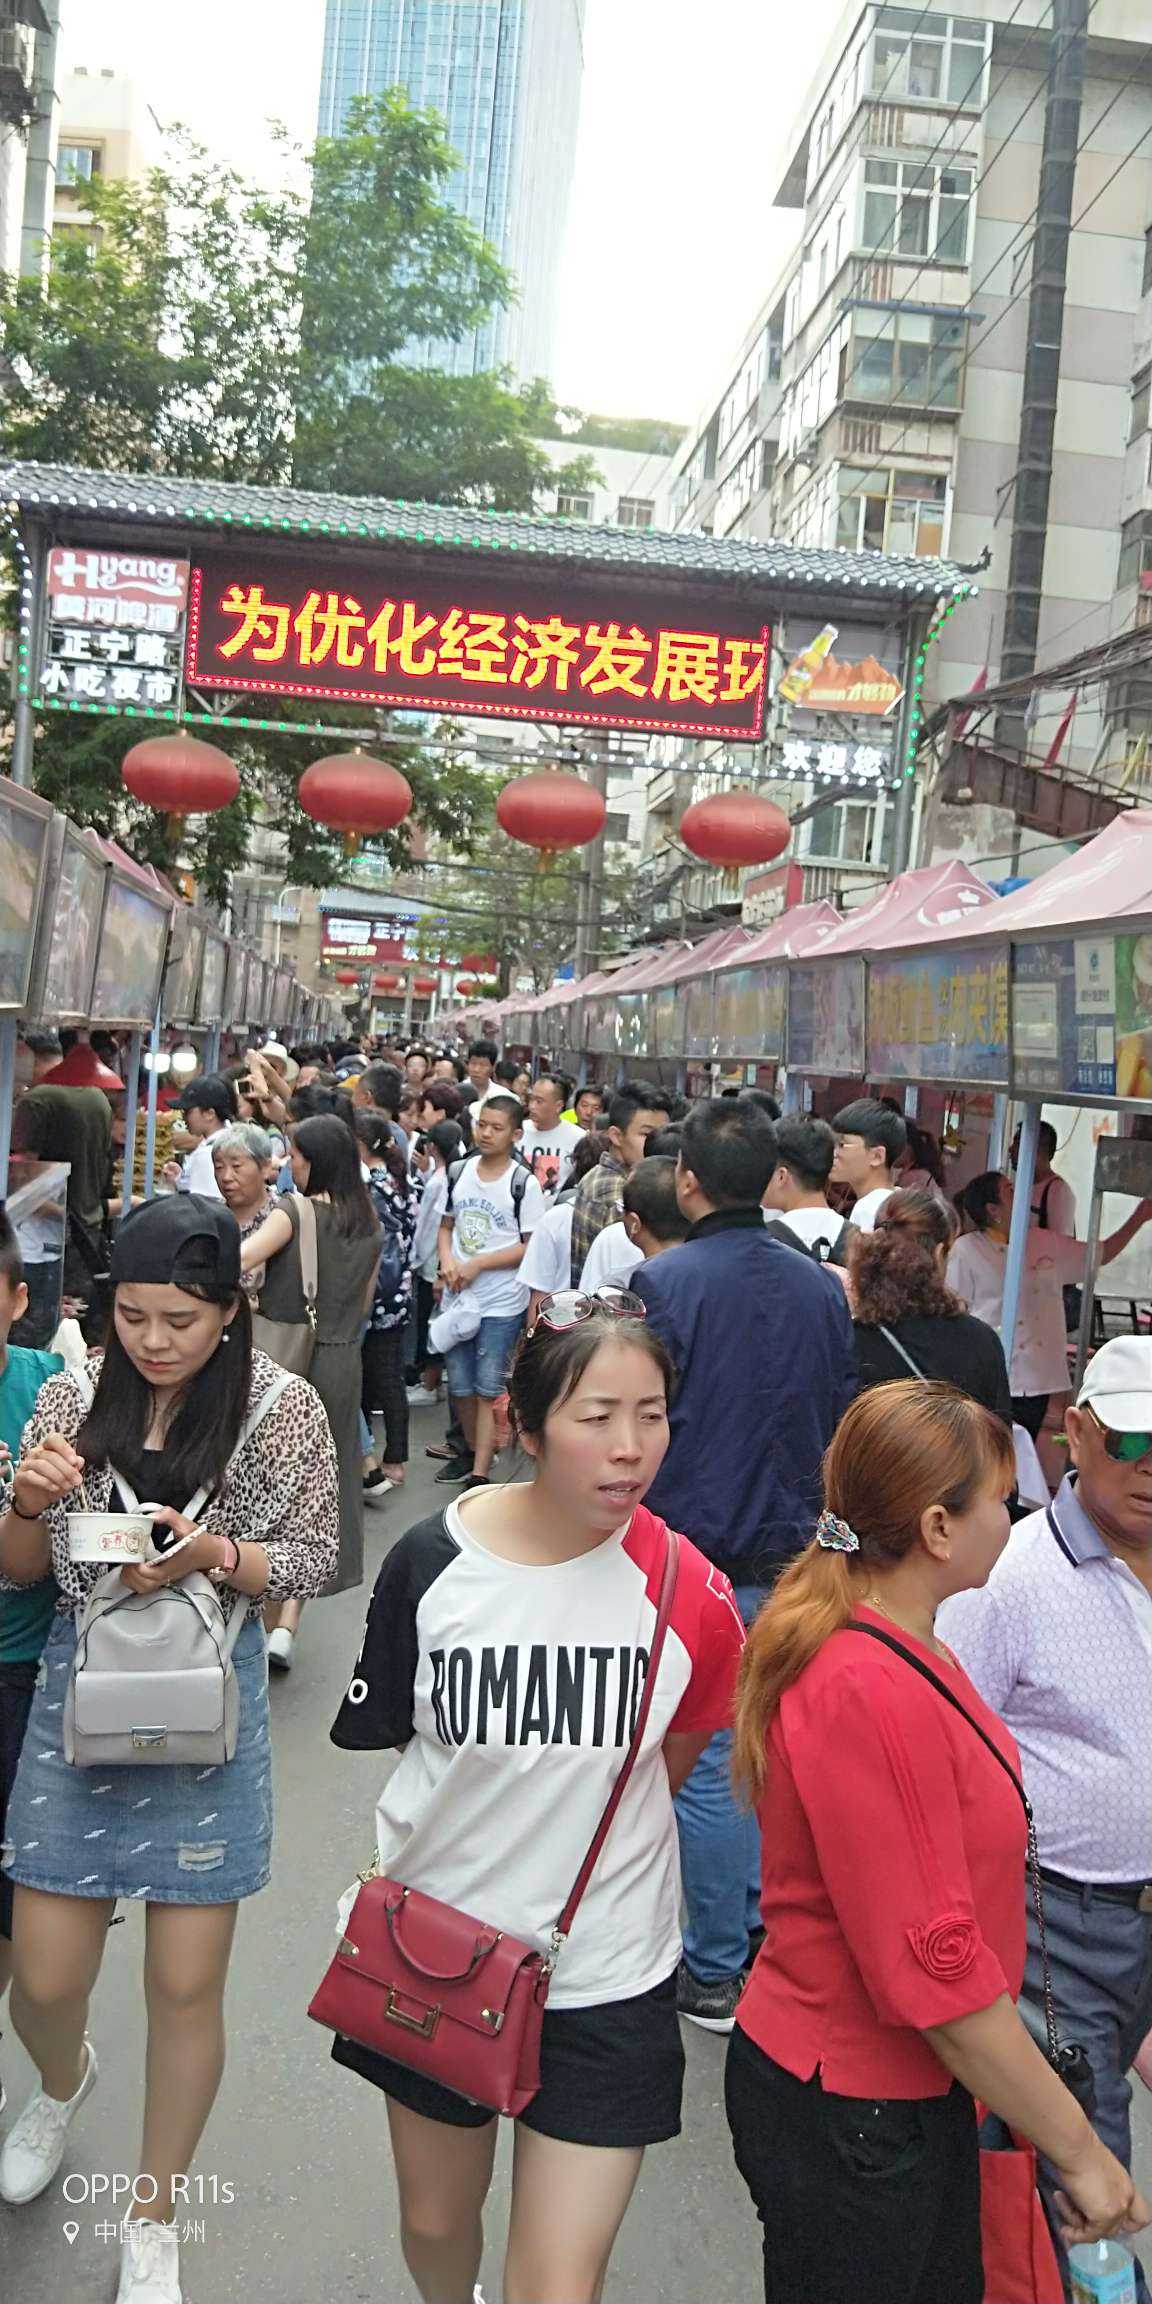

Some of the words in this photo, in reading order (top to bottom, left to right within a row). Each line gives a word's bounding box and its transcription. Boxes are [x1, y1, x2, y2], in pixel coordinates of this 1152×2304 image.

[60, 629, 168, 666] 正宁路
[40, 661, 176, 703] 小吃夜市
[782, 740, 882, 777] 欢迎您
[429, 1644, 651, 1748] ROMANTIC
